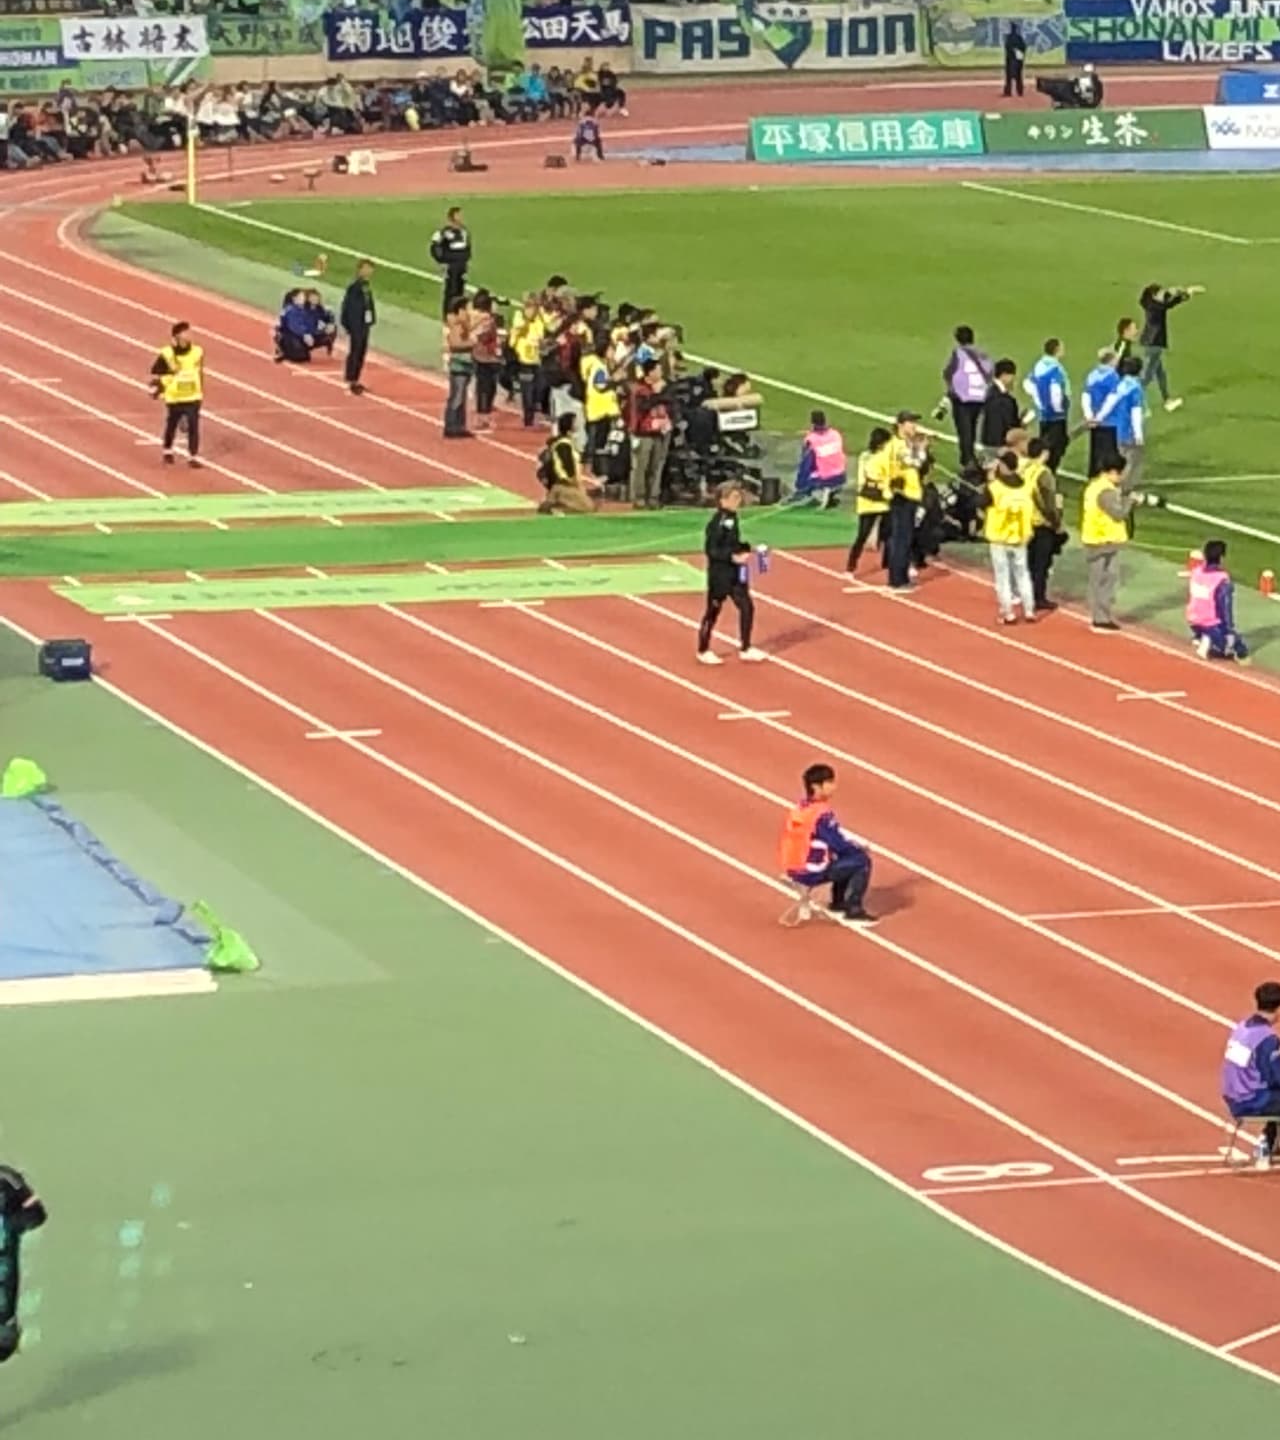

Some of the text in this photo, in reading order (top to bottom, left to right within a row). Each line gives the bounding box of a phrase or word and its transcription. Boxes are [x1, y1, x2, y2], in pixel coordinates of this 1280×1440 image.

[72, 23, 199, 54] 古林将太
[336, 15, 472, 54] 菊地俊
[1069, 15, 1216, 42] SHONAN
[1229, 16, 1262, 42] MI
[761, 118, 976, 155] 平塚信用金庫
[1081, 115, 1149, 146] 生茶
[922, 1162, 1055, 1183] 8
